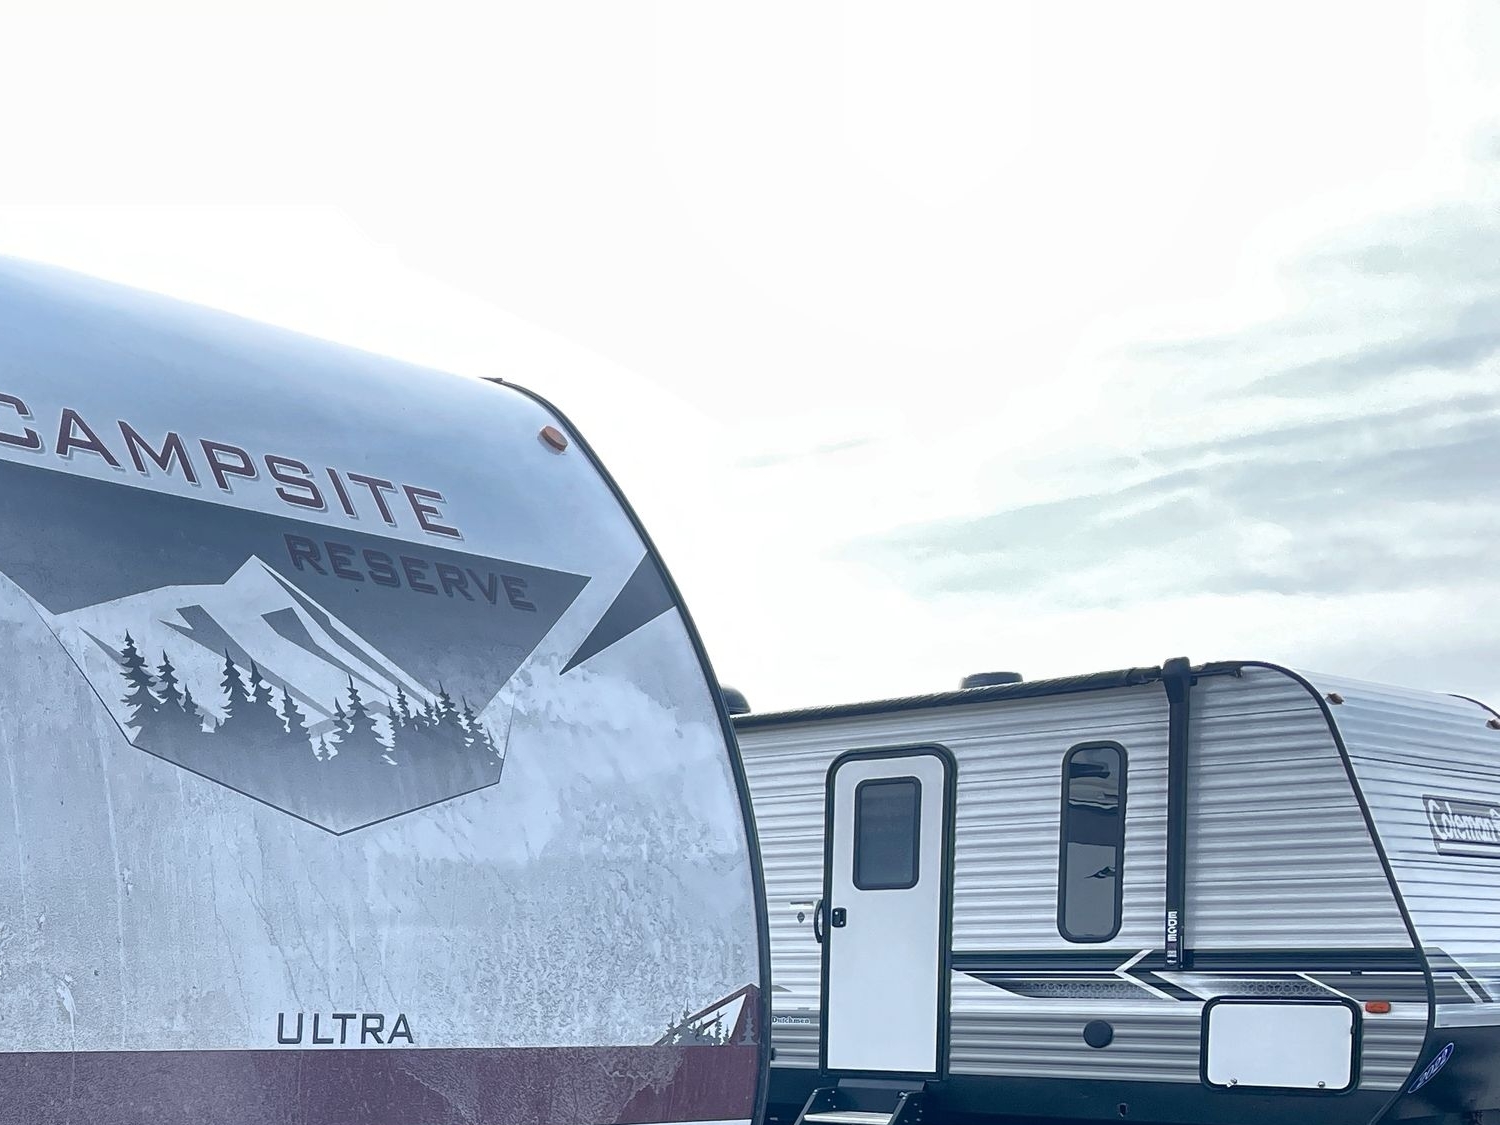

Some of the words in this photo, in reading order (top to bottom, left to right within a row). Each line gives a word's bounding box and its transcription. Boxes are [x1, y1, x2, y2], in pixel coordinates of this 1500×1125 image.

[283, 533, 537, 612] RESERVE
[1167, 911, 1178, 942] EDGE
[277, 1012, 414, 1045] ULTRA
